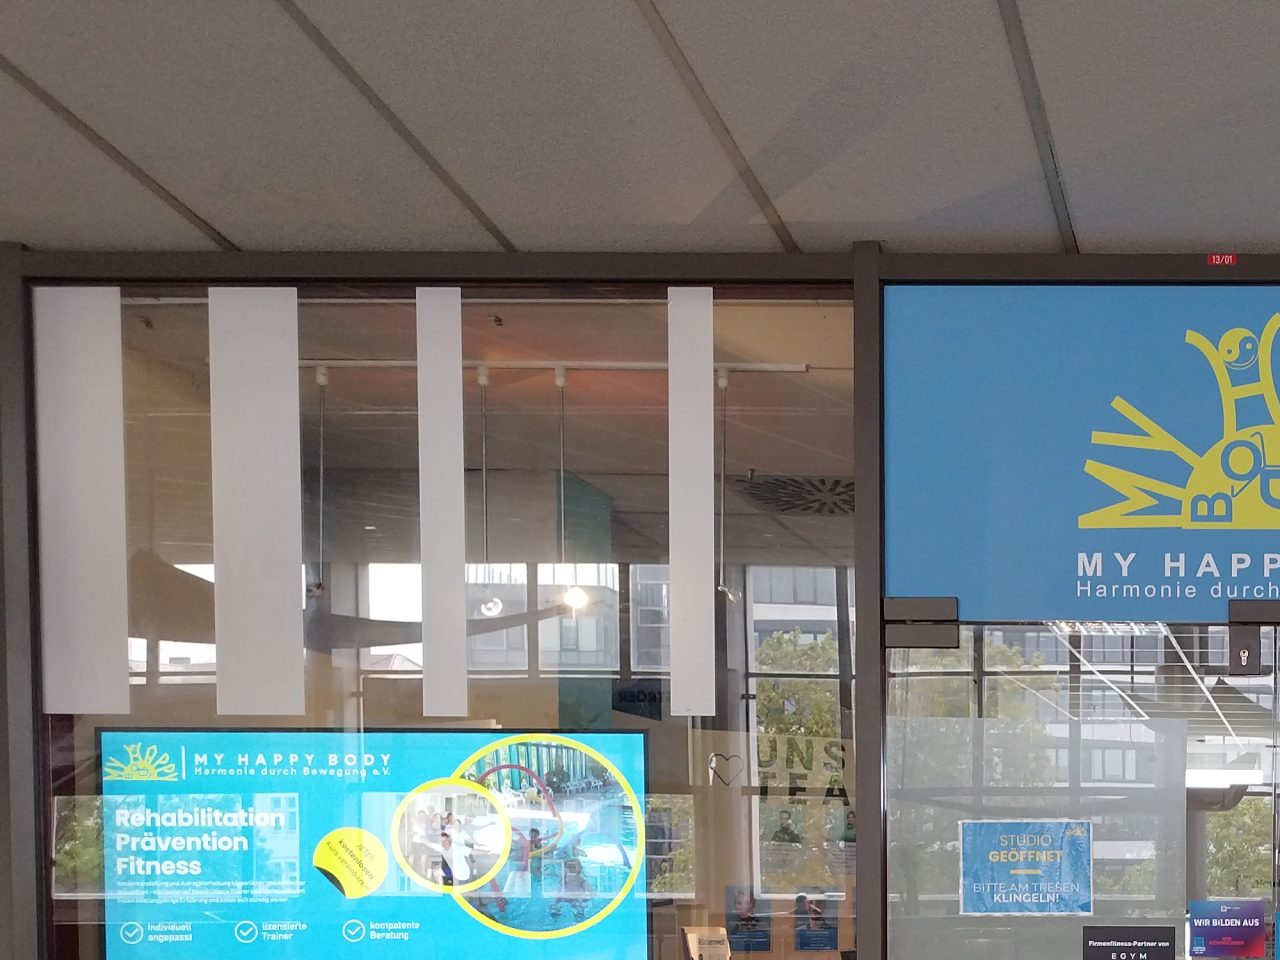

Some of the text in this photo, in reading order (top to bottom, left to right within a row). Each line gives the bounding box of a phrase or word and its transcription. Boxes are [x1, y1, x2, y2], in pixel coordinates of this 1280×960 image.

[1212, 255, 1232, 264] 13/01
[1076, 553, 1137, 577] MY
[1076, 580, 1196, 598] Harmonie
[1210, 581, 1279, 599] durch
[194, 753, 391, 766] MY HAPPY BODY
[194, 766, 255, 776] Harmonie
[261, 766, 297, 776] durch
[303, 766, 366, 778] Bewegung
[115, 806, 286, 828] Rehabilitation
[115, 831, 249, 852] Prävention
[999, 834, 1052, 847] STUDIO
[988, 848, 1063, 862] GEÖFFNET
[115, 856, 202, 876] Fitness
[973, 882, 1080, 893] BITTE AM TRESEN
[993, 893, 1060, 903] KLINGELN!
[1193, 918, 1260, 927] WIR BILDEN AUS
[262, 932, 293, 941] Trainer
[370, 931, 409, 941] Beratung
[1111, 952, 1147, 960] EGYM
